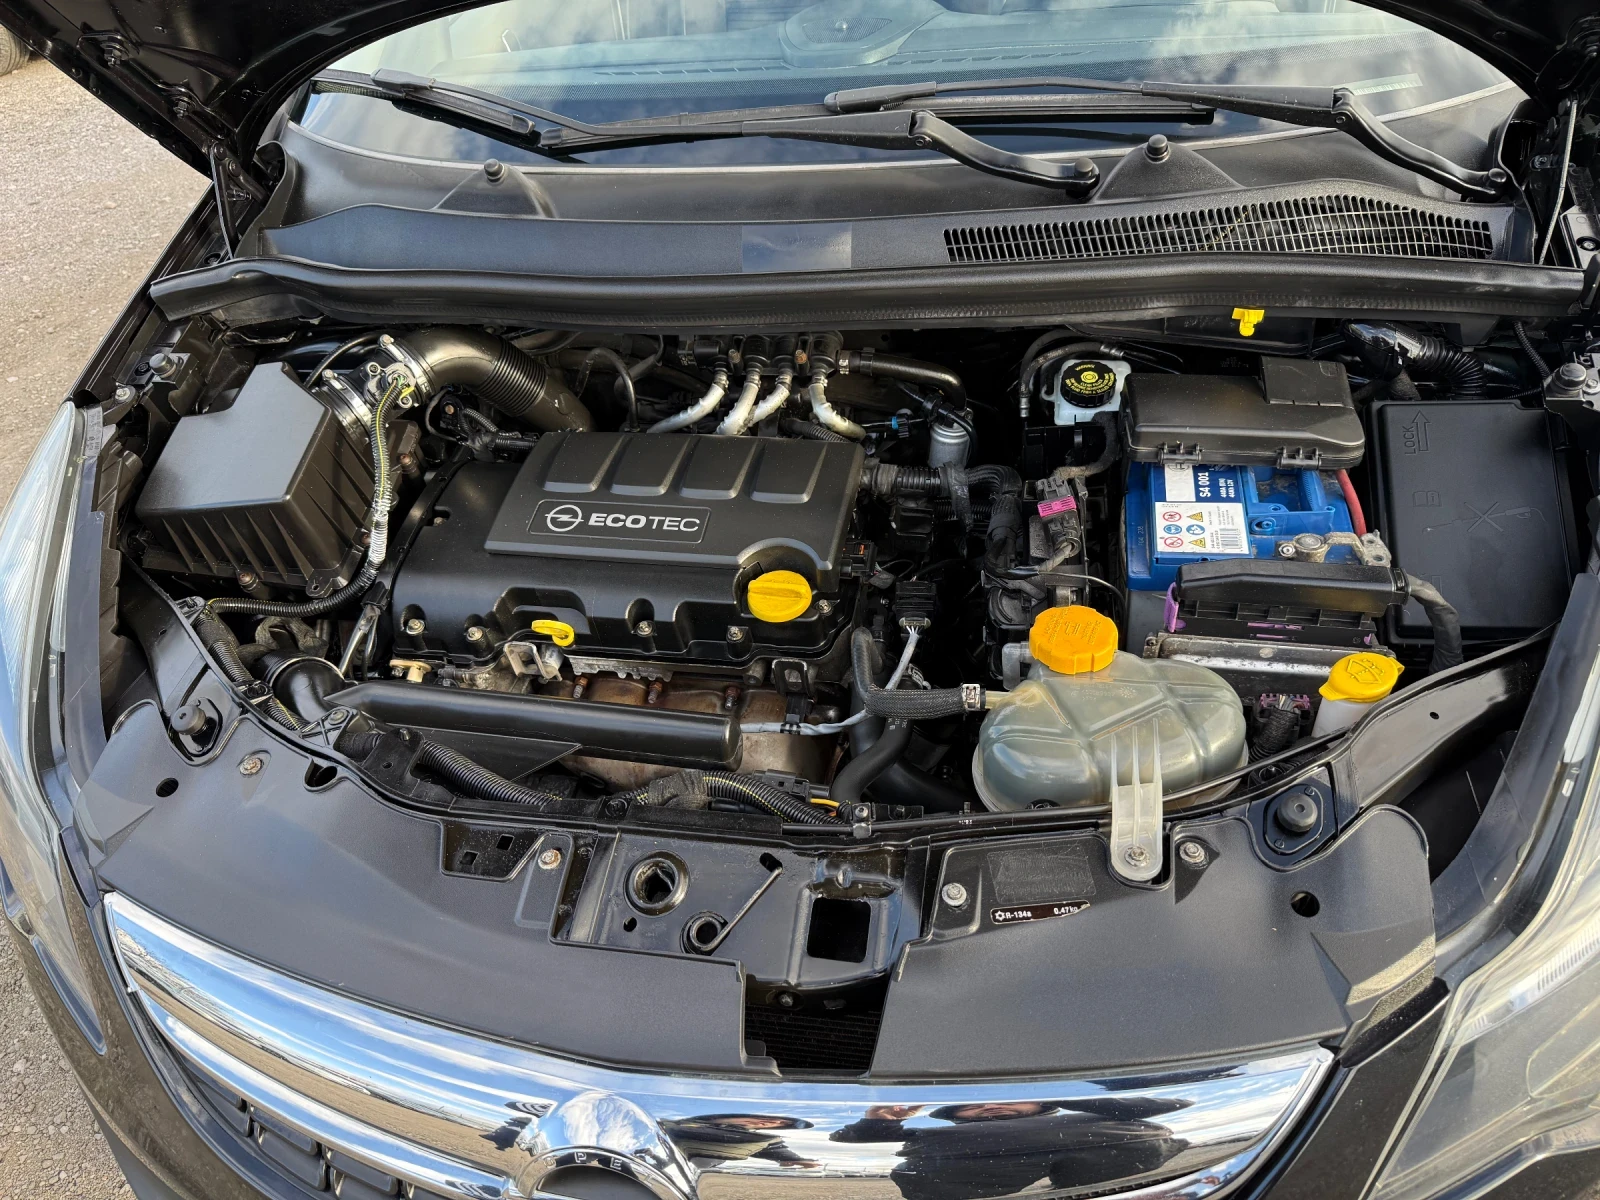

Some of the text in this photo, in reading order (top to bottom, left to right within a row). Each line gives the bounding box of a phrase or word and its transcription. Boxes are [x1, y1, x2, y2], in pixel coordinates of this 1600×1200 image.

[1402, 426, 1416, 454] LOCK
[1198, 472, 1210, 486] 001
[1199, 487, 1211, 498] S4
[587, 512, 701, 532] ECOTEC
[1005, 910, 1032, 919] R-134a
[544, 1151, 656, 1187] OPEL
